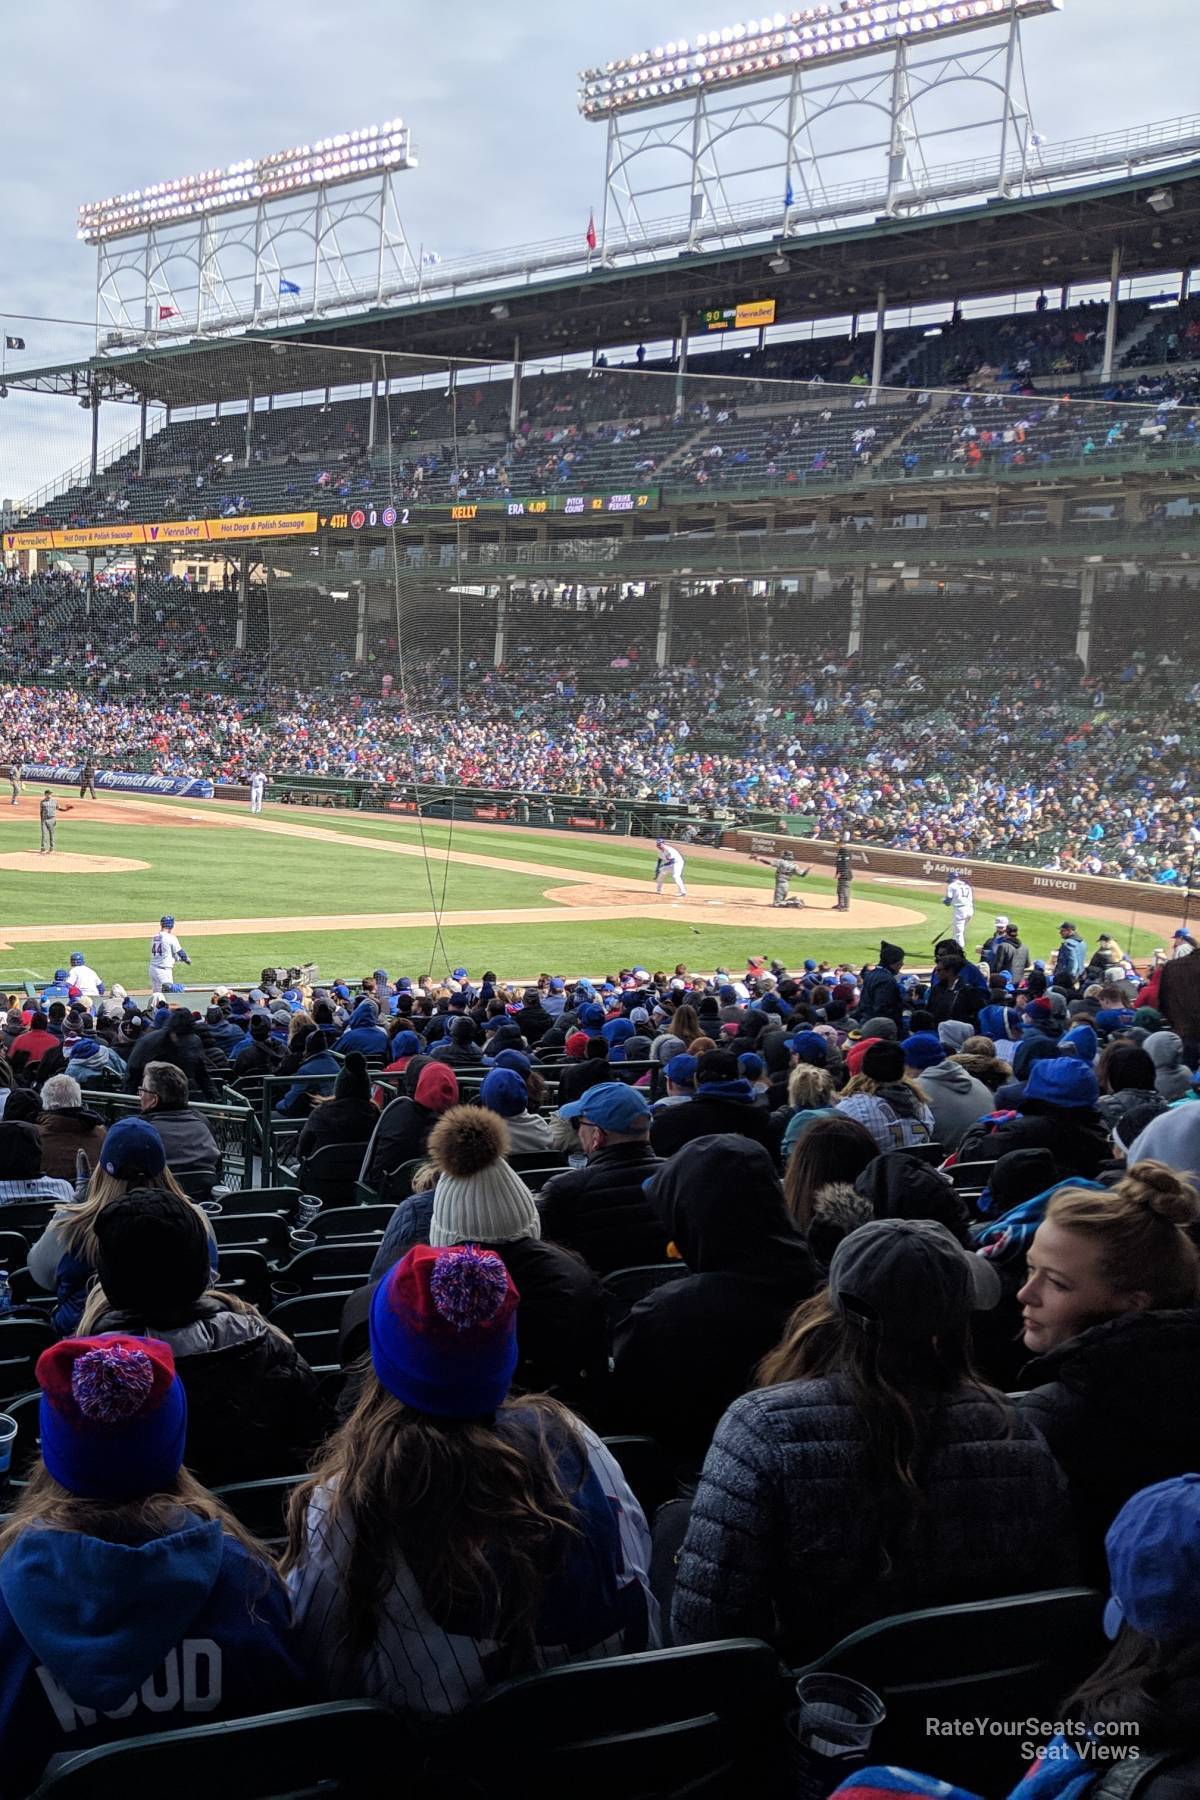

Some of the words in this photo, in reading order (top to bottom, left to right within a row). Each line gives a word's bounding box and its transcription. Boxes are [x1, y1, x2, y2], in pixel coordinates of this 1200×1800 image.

[608, 502, 634, 510] PERCENT
[638, 496, 648, 505] 57
[508, 504, 524, 514] ERA
[528, 502, 545, 512] 4.09
[330, 515, 348, 528] 4TH
[370, 511, 376, 526] 0
[402, 509, 409, 524] 2
[452, 506, 477, 519] KELLY
[164, 528, 185, 536] Vienna
[234, 523, 249, 532] Dogs
[257, 521, 276, 530] Polish
[278, 520, 304, 529] Sausage
[18, 537, 35, 546] Vienna
[21, 766, 55, 778] eynolds
[56, 768, 79, 781] Wrap
[101, 772, 146, 788] Reynolds
[148, 776, 175, 791] Wrap
[935, 864, 972, 876] Advocate
[1033, 876, 1076, 890] nuveen
[152, 943, 162, 956] 44
